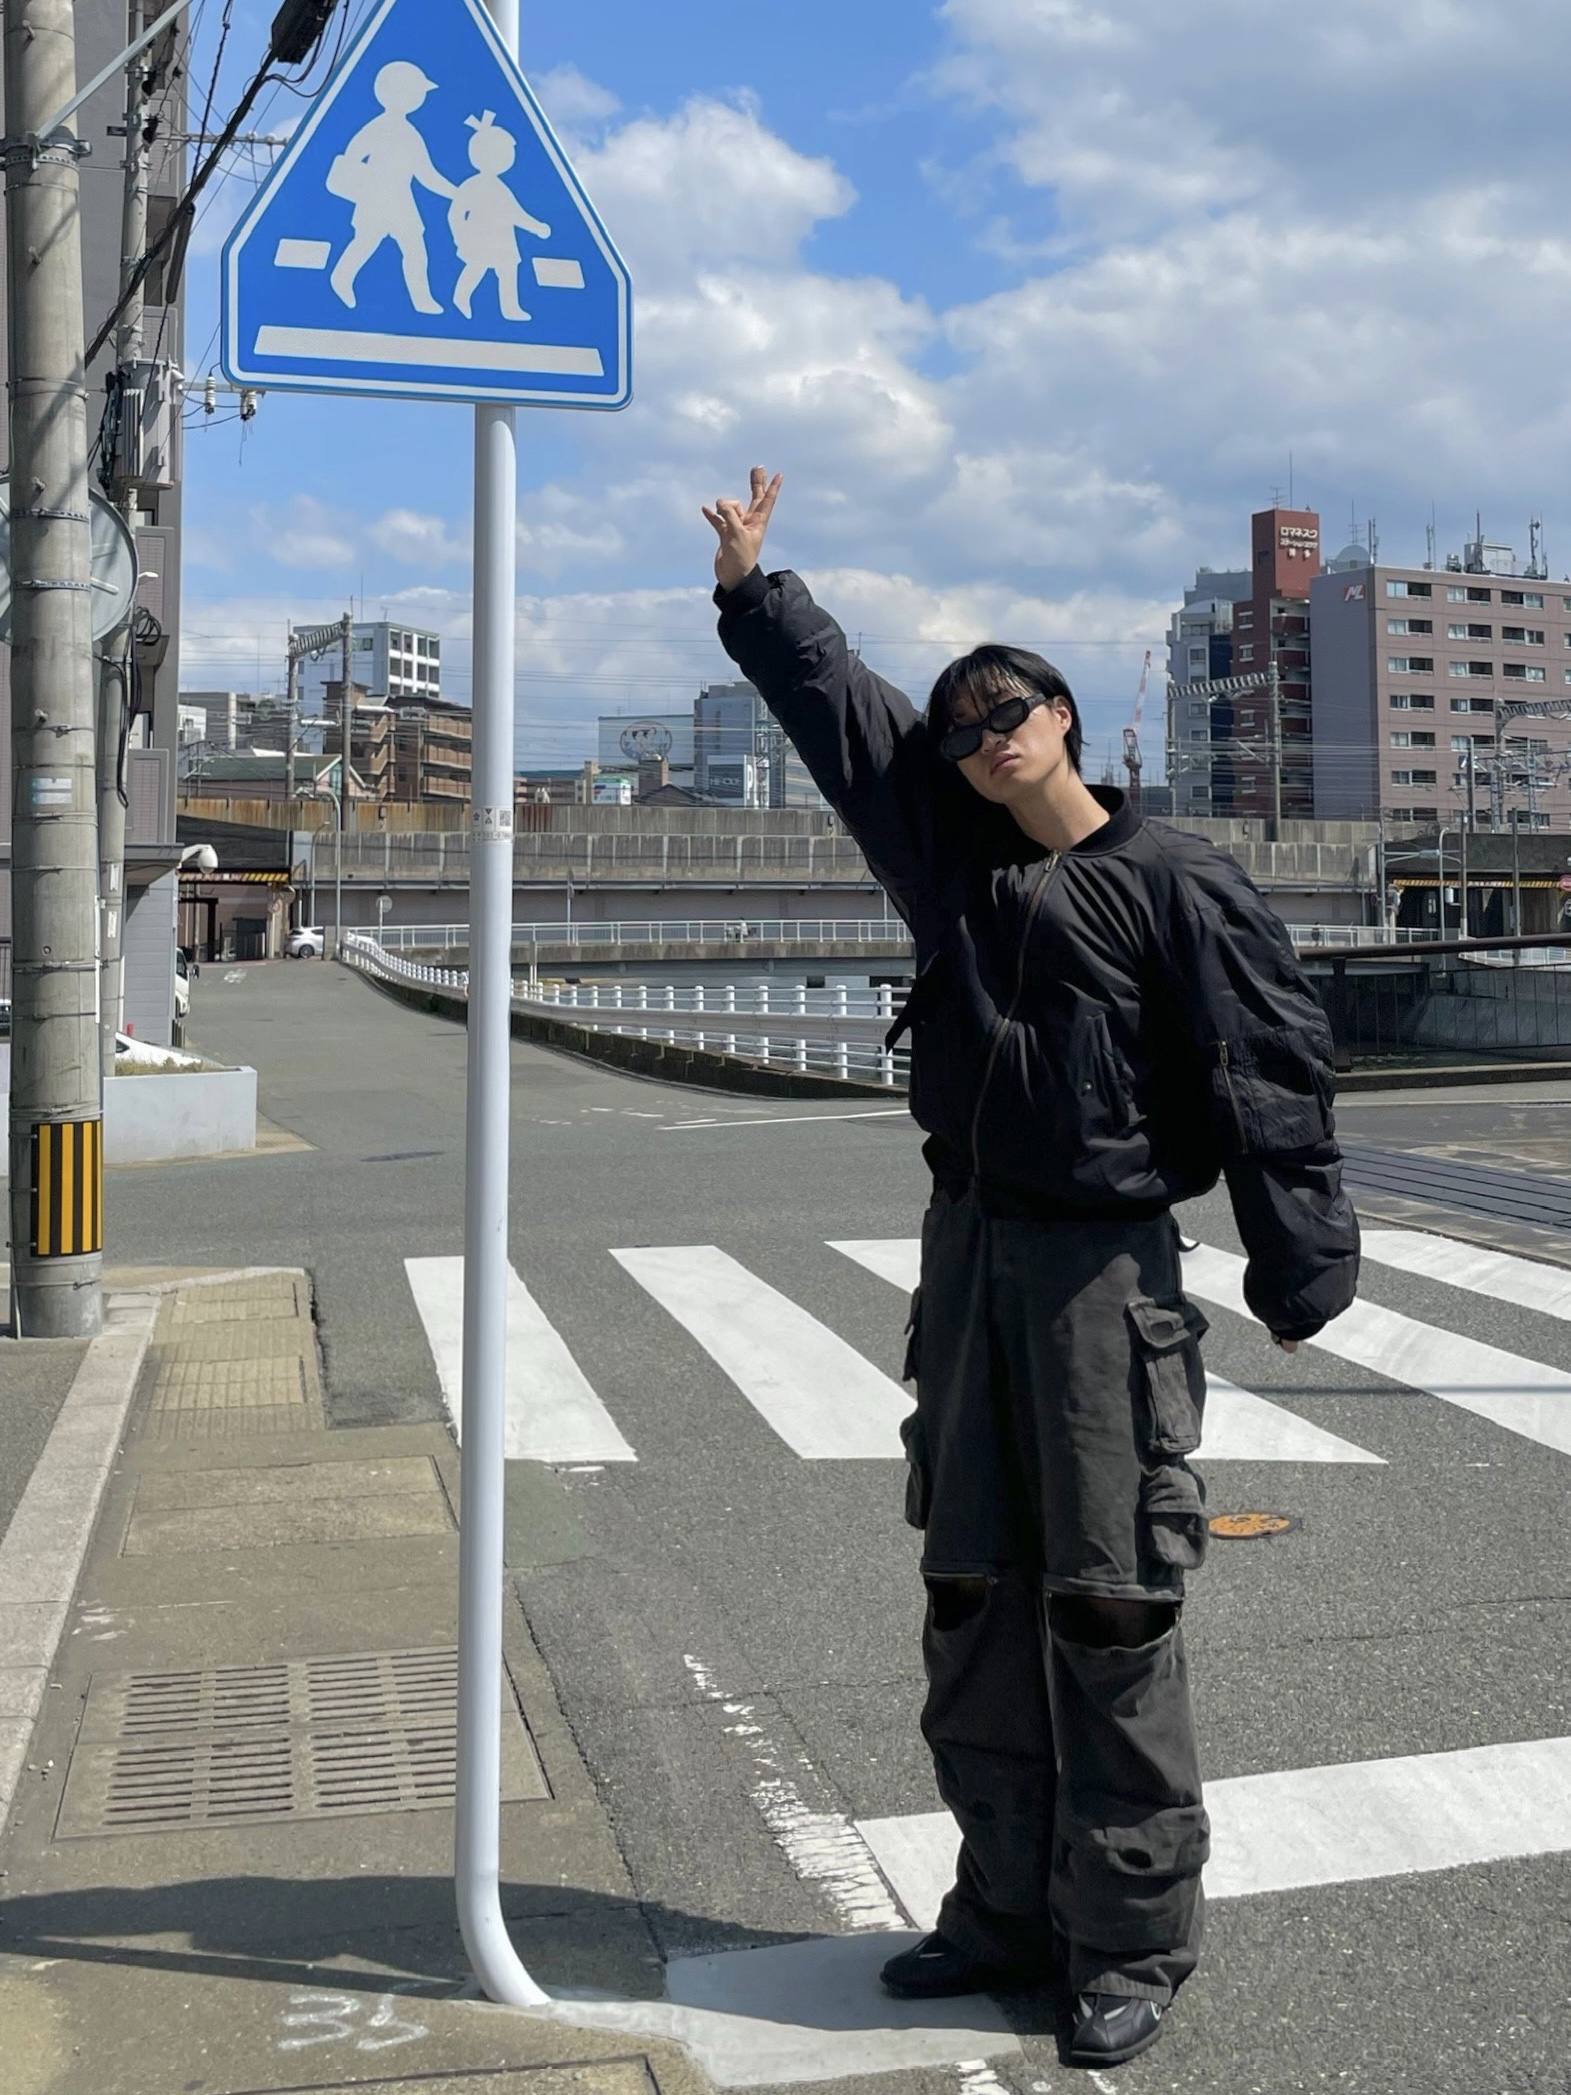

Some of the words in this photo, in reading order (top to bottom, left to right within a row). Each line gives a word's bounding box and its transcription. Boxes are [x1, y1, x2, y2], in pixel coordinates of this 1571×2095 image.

[1281, 526, 1317, 539] ロマネスク
